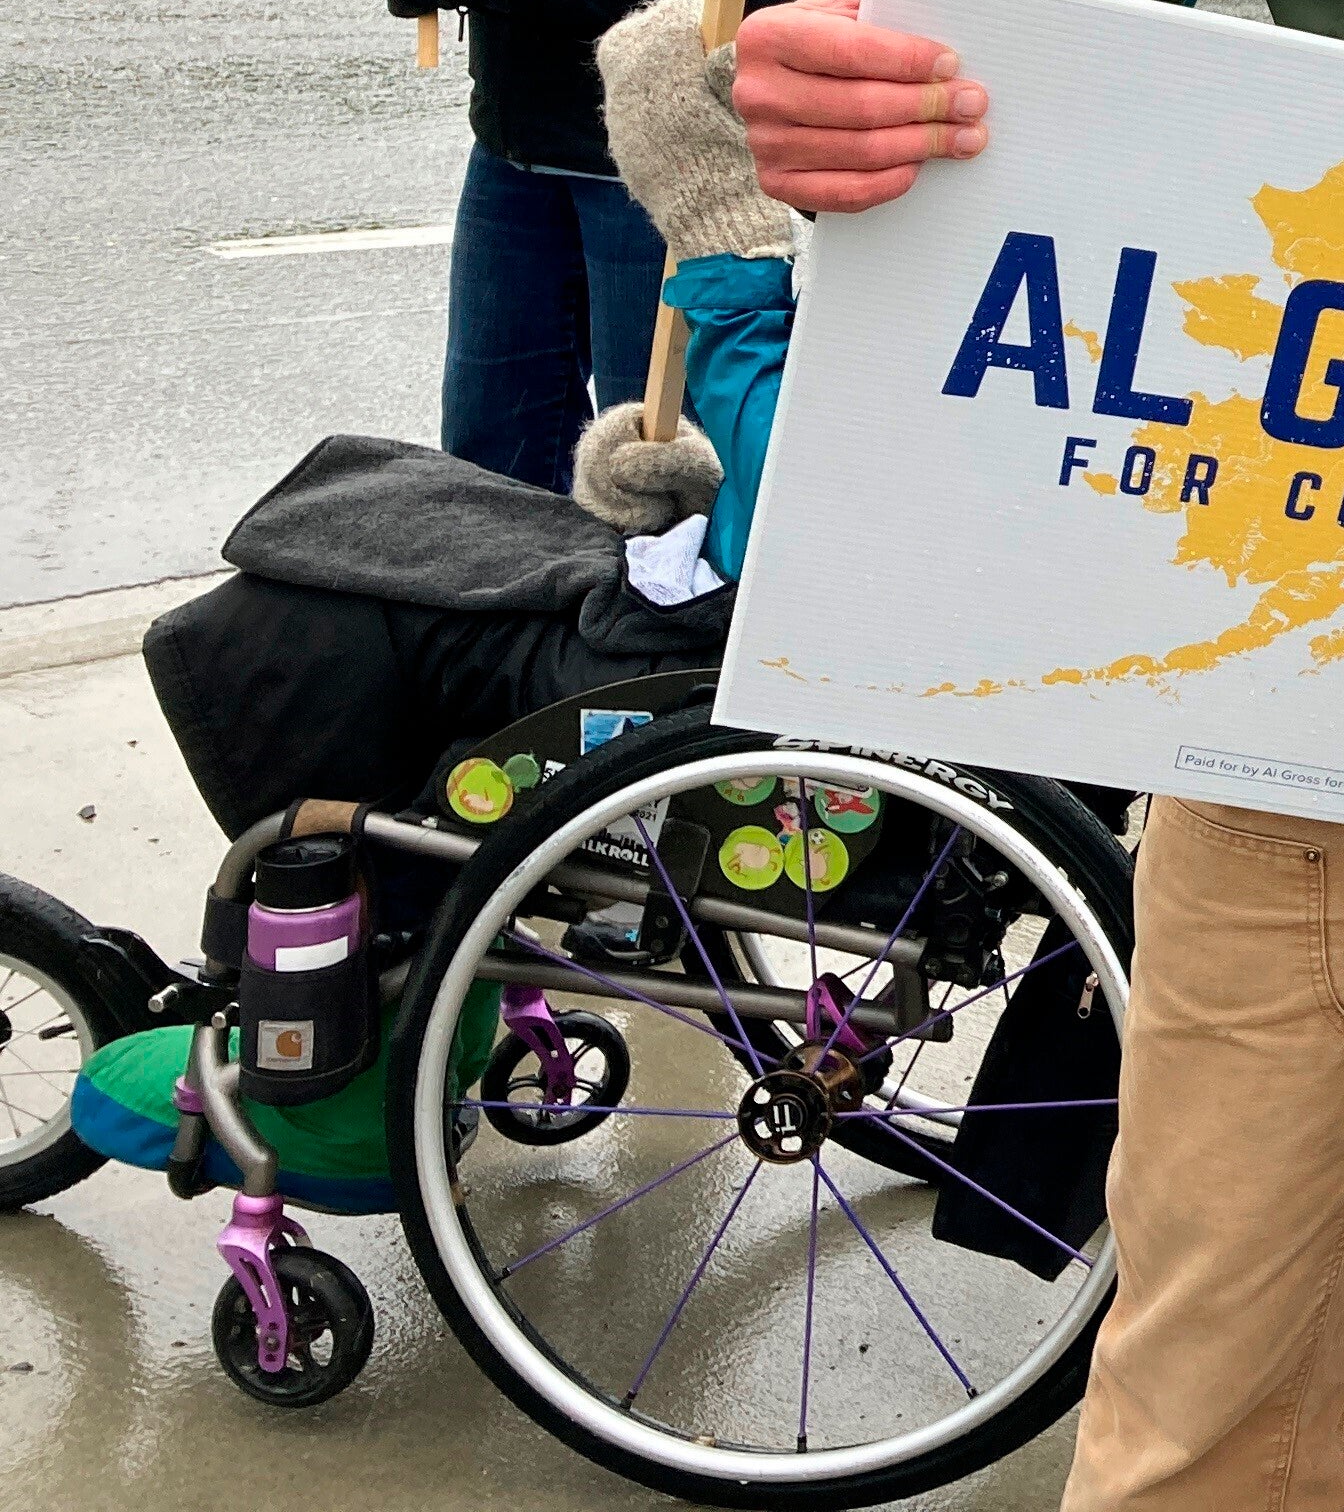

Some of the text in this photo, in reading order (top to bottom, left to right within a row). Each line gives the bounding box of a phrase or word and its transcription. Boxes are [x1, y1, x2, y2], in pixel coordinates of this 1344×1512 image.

[941, 231, 1194, 427] AL
[1058, 436, 1219, 506] FOR
[1184, 753, 1215, 769] Paid
[1219, 759, 1238, 773] for
[1242, 763, 1259, 777] by
[1262, 765, 1277, 778] Al
[1281, 769, 1321, 786] Gross
[1324, 775, 1344, 789] for
